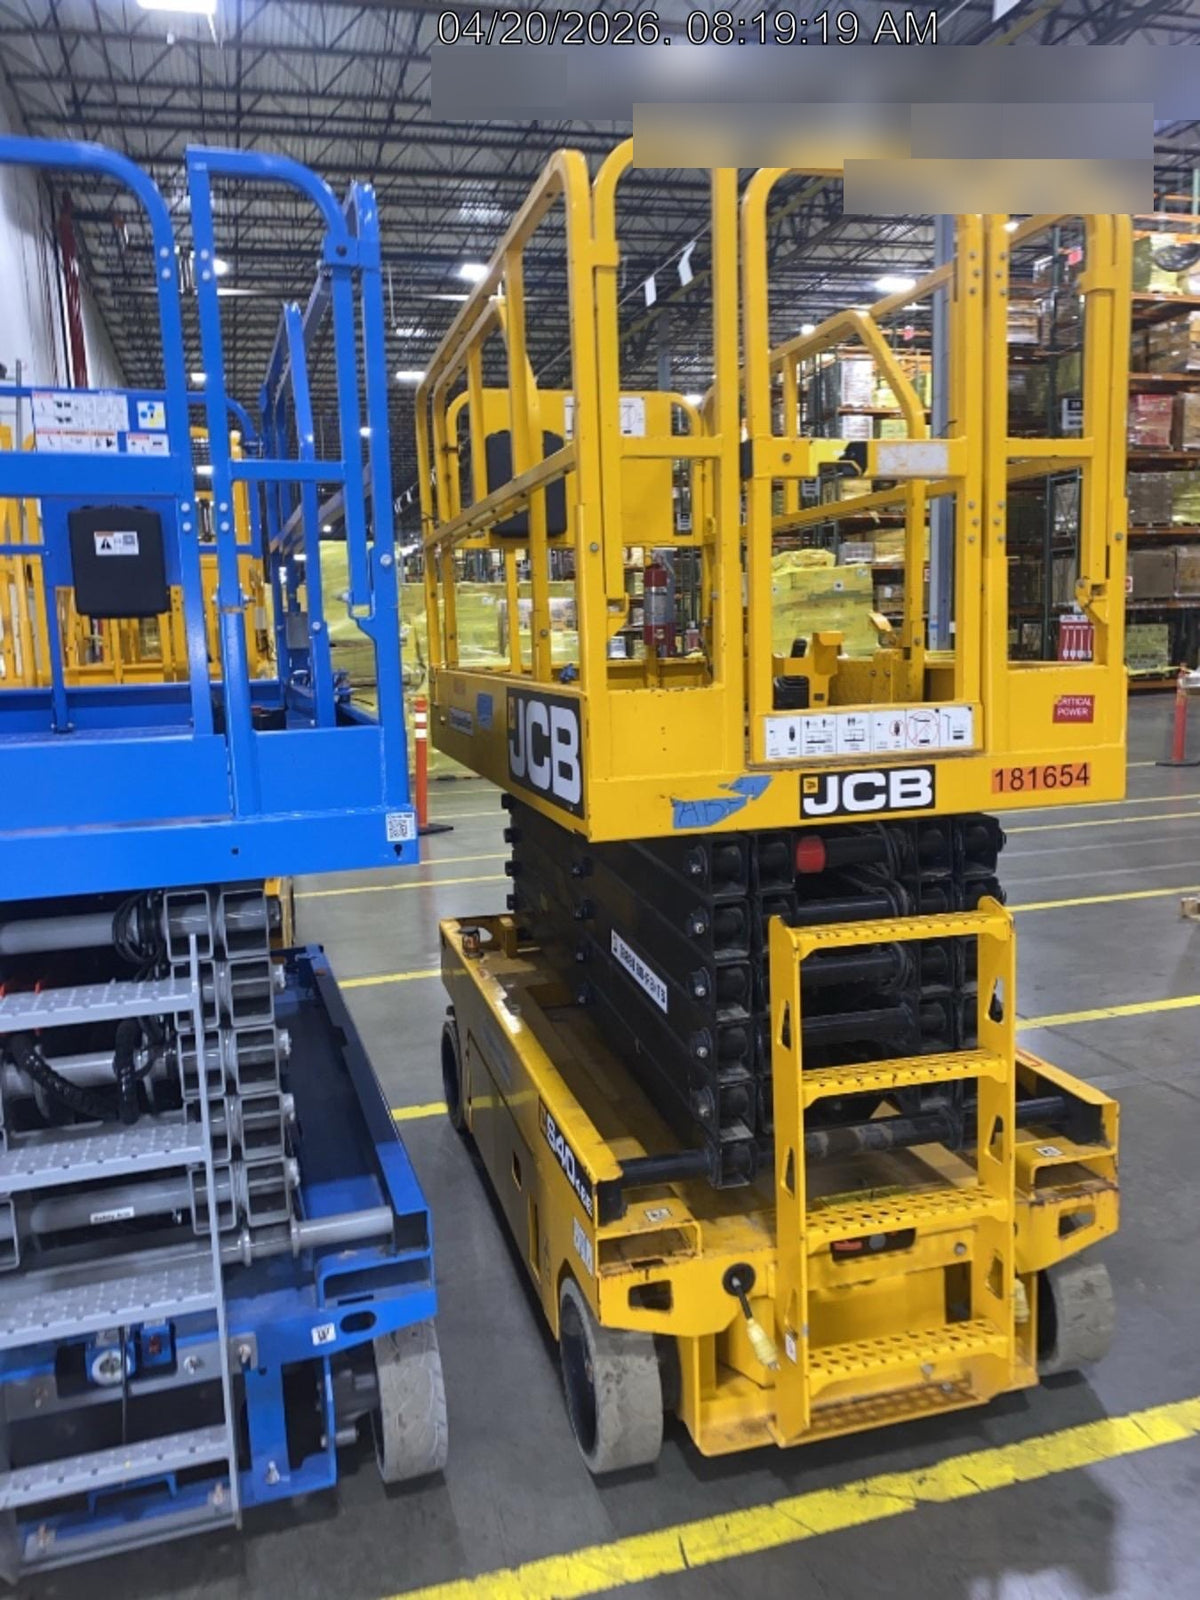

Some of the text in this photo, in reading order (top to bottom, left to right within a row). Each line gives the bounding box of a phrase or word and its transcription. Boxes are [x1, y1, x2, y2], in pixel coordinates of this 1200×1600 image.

[1057, 707, 1089, 716] POWER
[508, 697, 582, 805] JCB
[803, 769, 933, 815] JCB
[995, 762, 1090, 792] 181654
